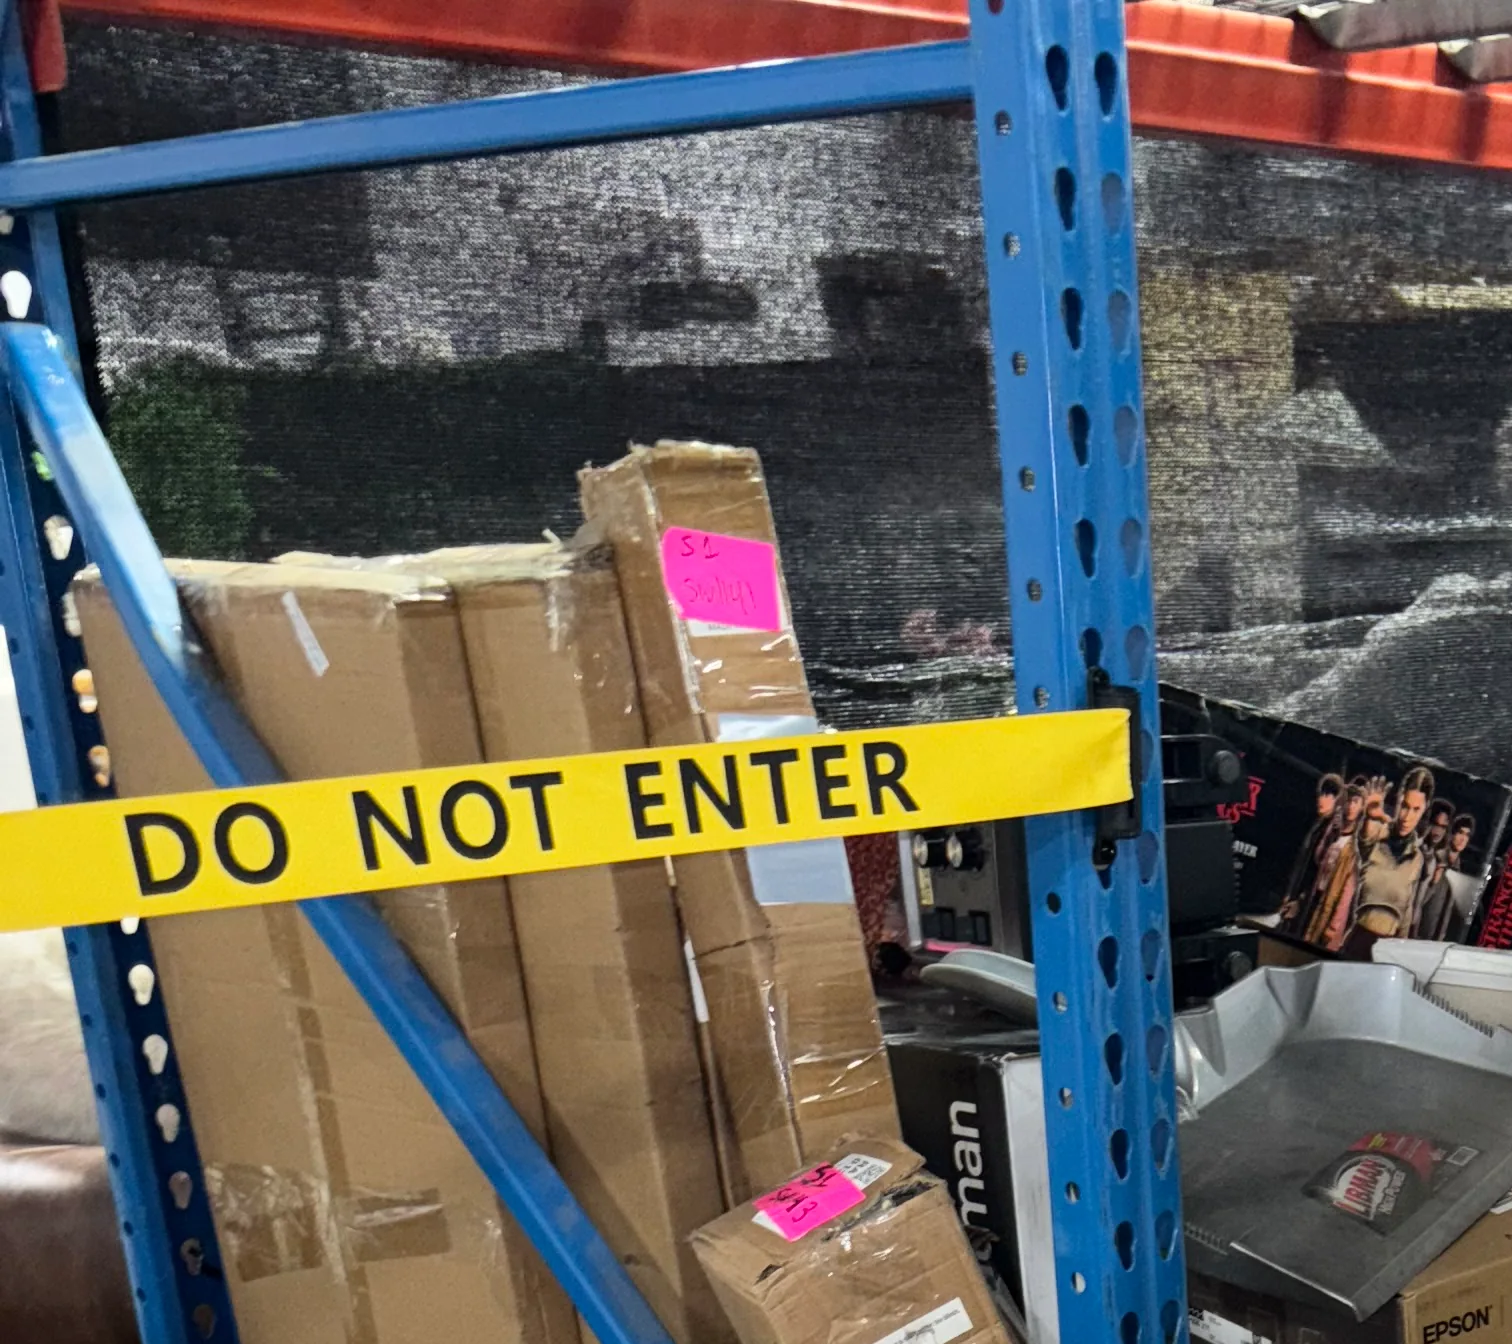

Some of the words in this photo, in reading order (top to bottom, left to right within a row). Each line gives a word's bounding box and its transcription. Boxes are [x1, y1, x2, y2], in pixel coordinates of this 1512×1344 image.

[123, 801, 289, 896] DO
[351, 771, 563, 872] NOT
[624, 741, 921, 840] ENTER
[949, 1101, 989, 1238] man
[1332, 1159, 1383, 1219] LIBMAN
